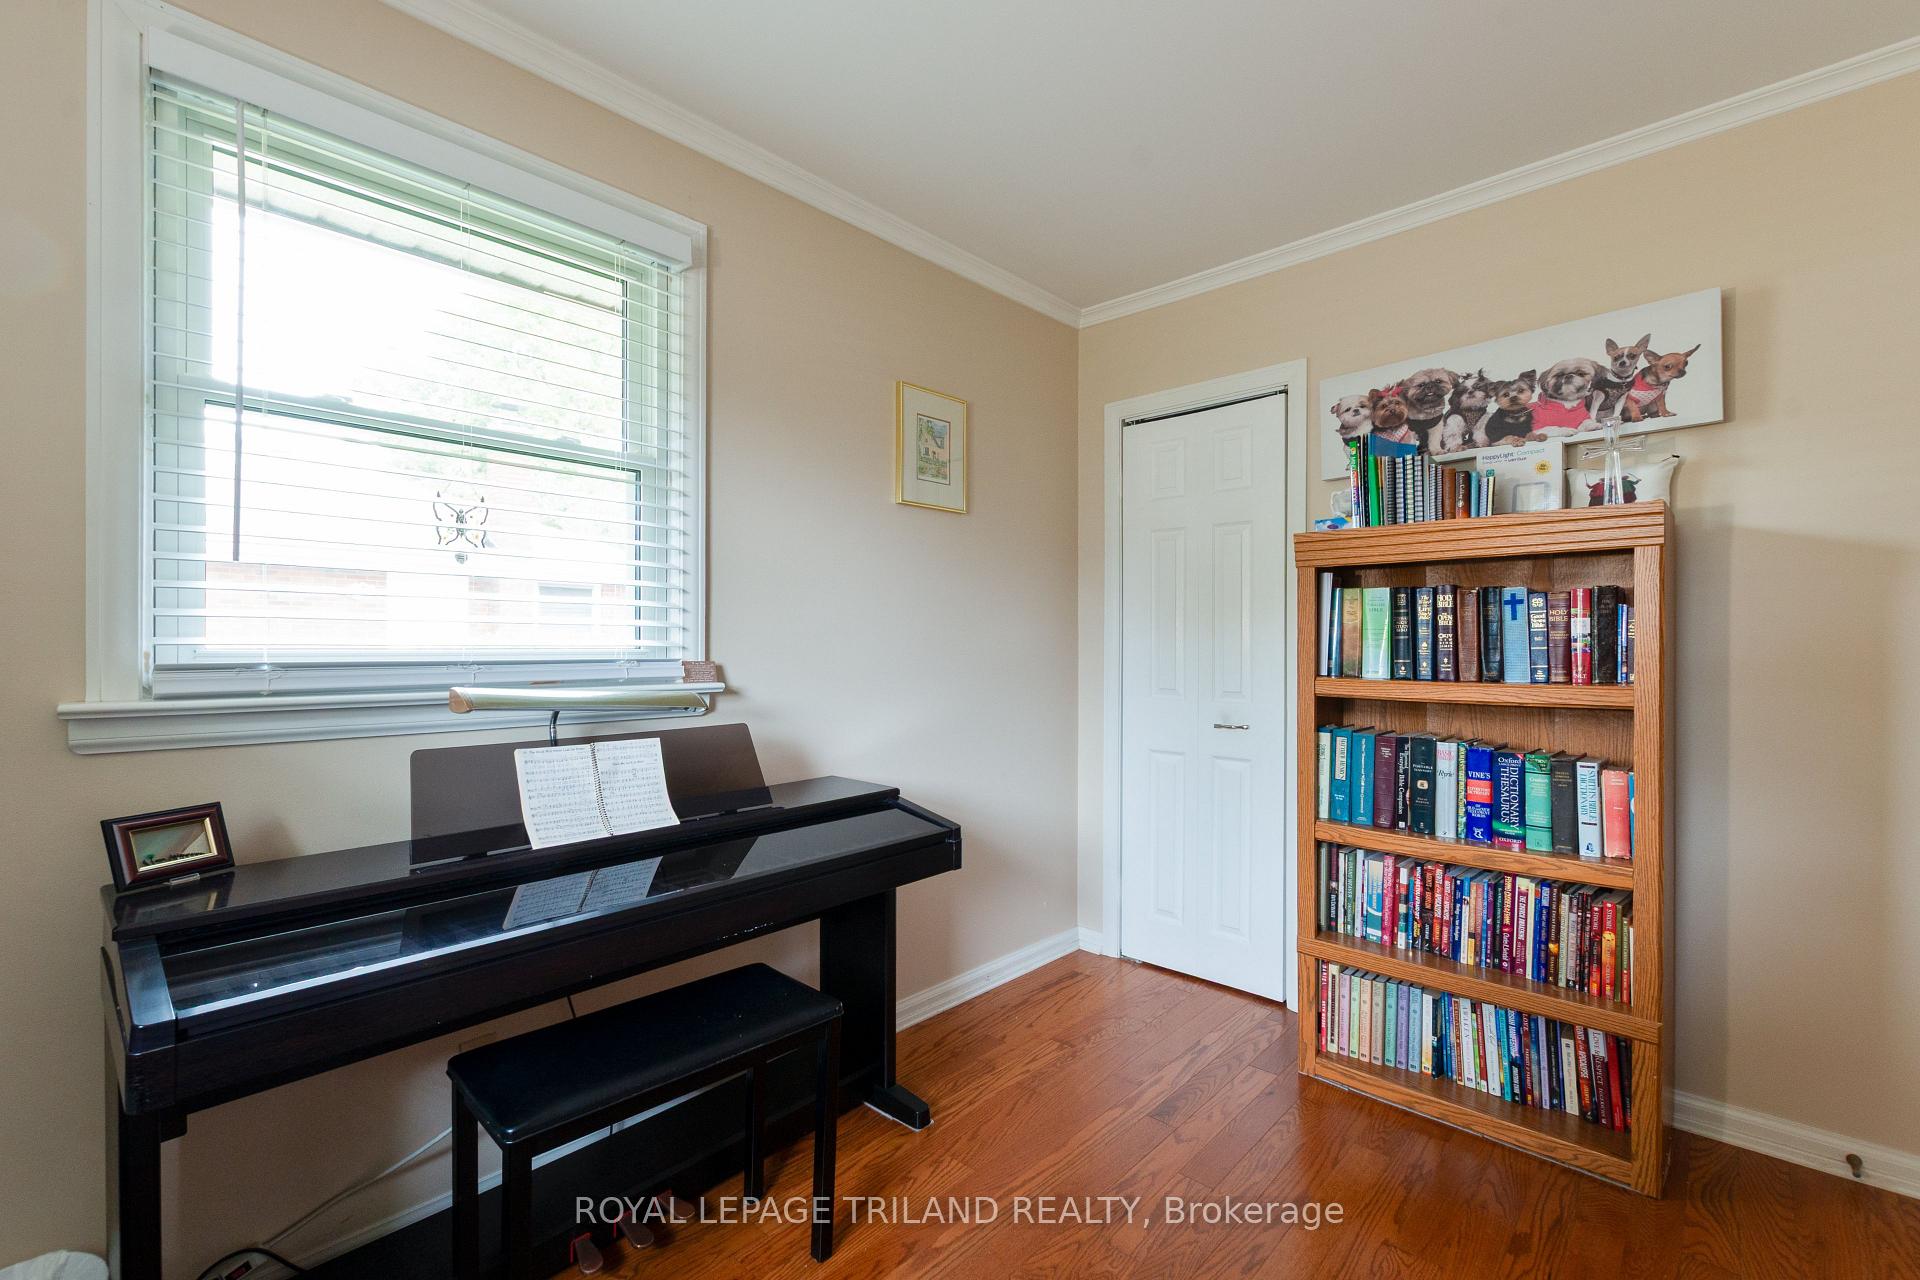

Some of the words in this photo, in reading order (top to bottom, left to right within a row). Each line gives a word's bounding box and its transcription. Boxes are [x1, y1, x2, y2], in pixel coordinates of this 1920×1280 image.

[1501, 767, 1509, 823] THESAURUS
[1510, 767, 1520, 831] DICTIONARY
[1588, 800, 1597, 821] BIBLE
[1579, 1051, 1588, 1078] APOCALYPSE
[1595, 1056, 1604, 1085] RESPECT
